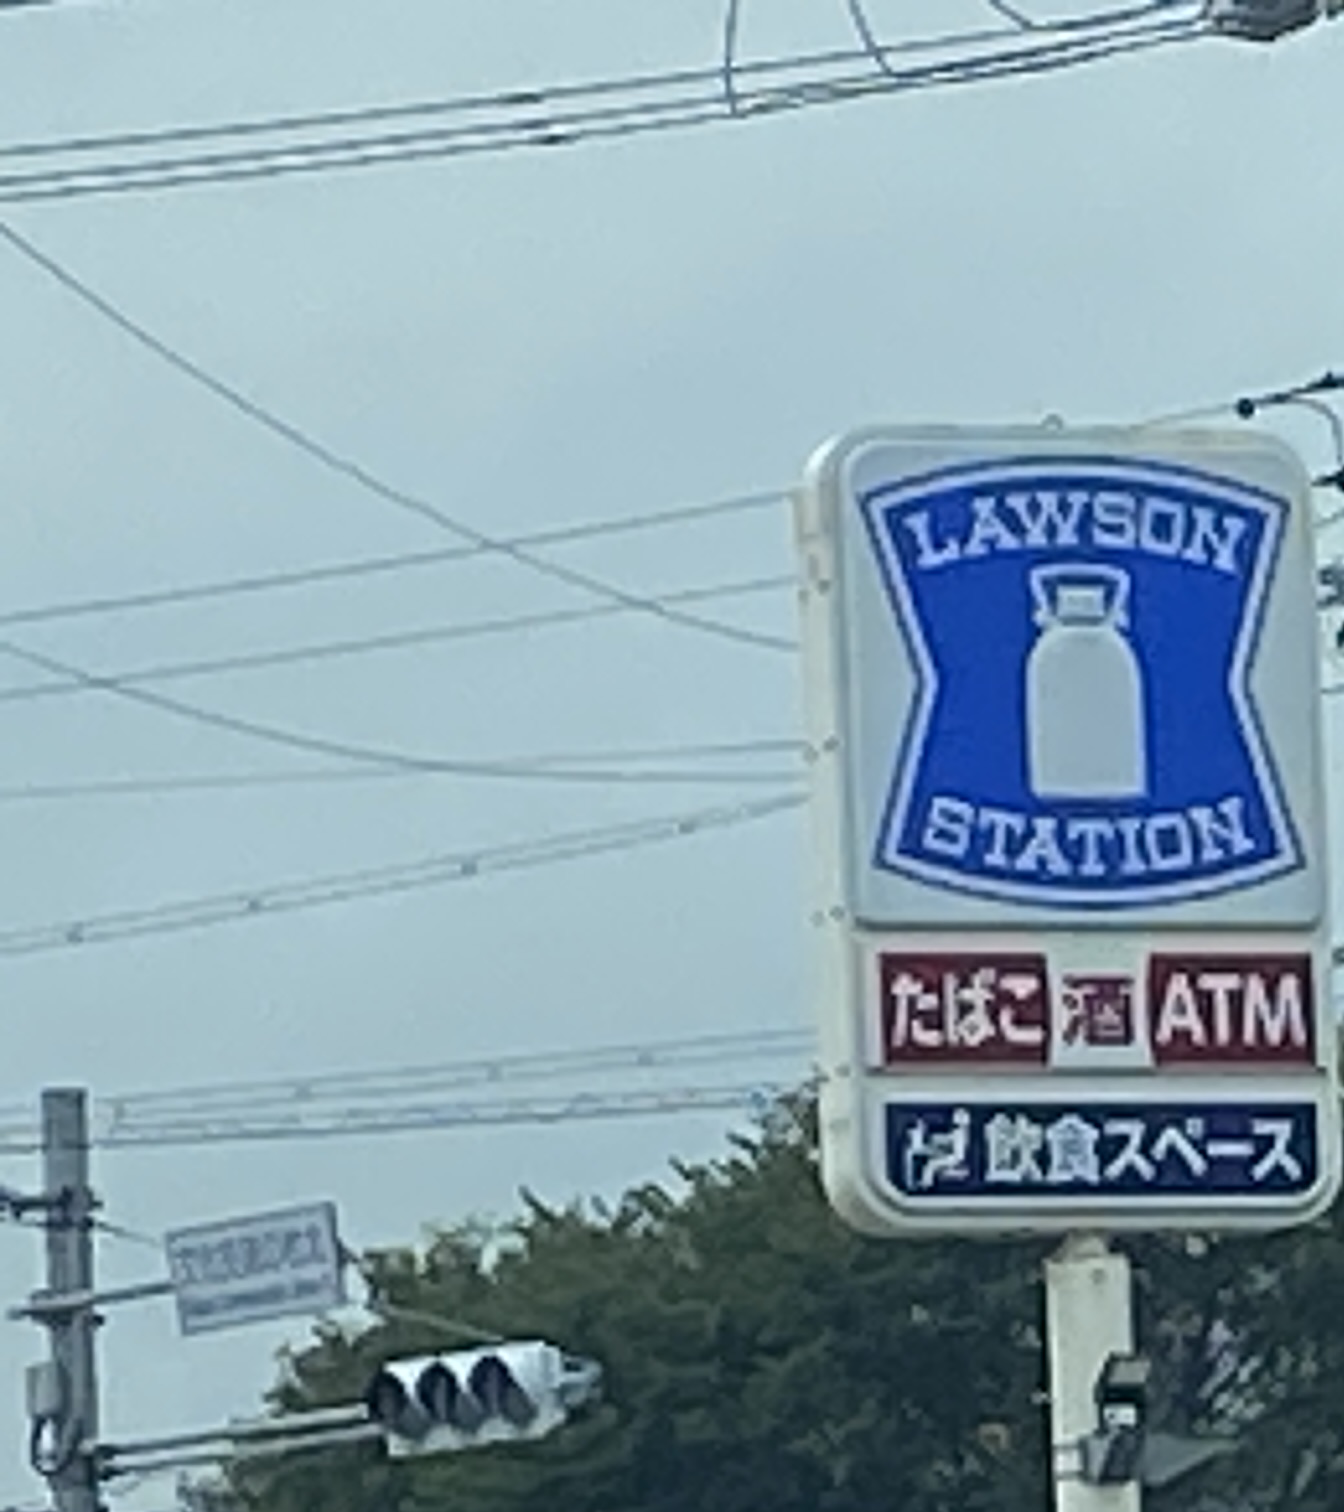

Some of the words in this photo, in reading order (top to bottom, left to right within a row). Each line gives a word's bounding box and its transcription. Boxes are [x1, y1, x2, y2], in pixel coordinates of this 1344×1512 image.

[904, 489, 1247, 571] LAWSON
[921, 796, 1255, 877] STATION
[891, 967, 1046, 1048] たばこ
[1062, 976, 1136, 1047] 酒
[1156, 972, 1308, 1048] ATM
[983, 1111, 1303, 1186] 飲食スペース
